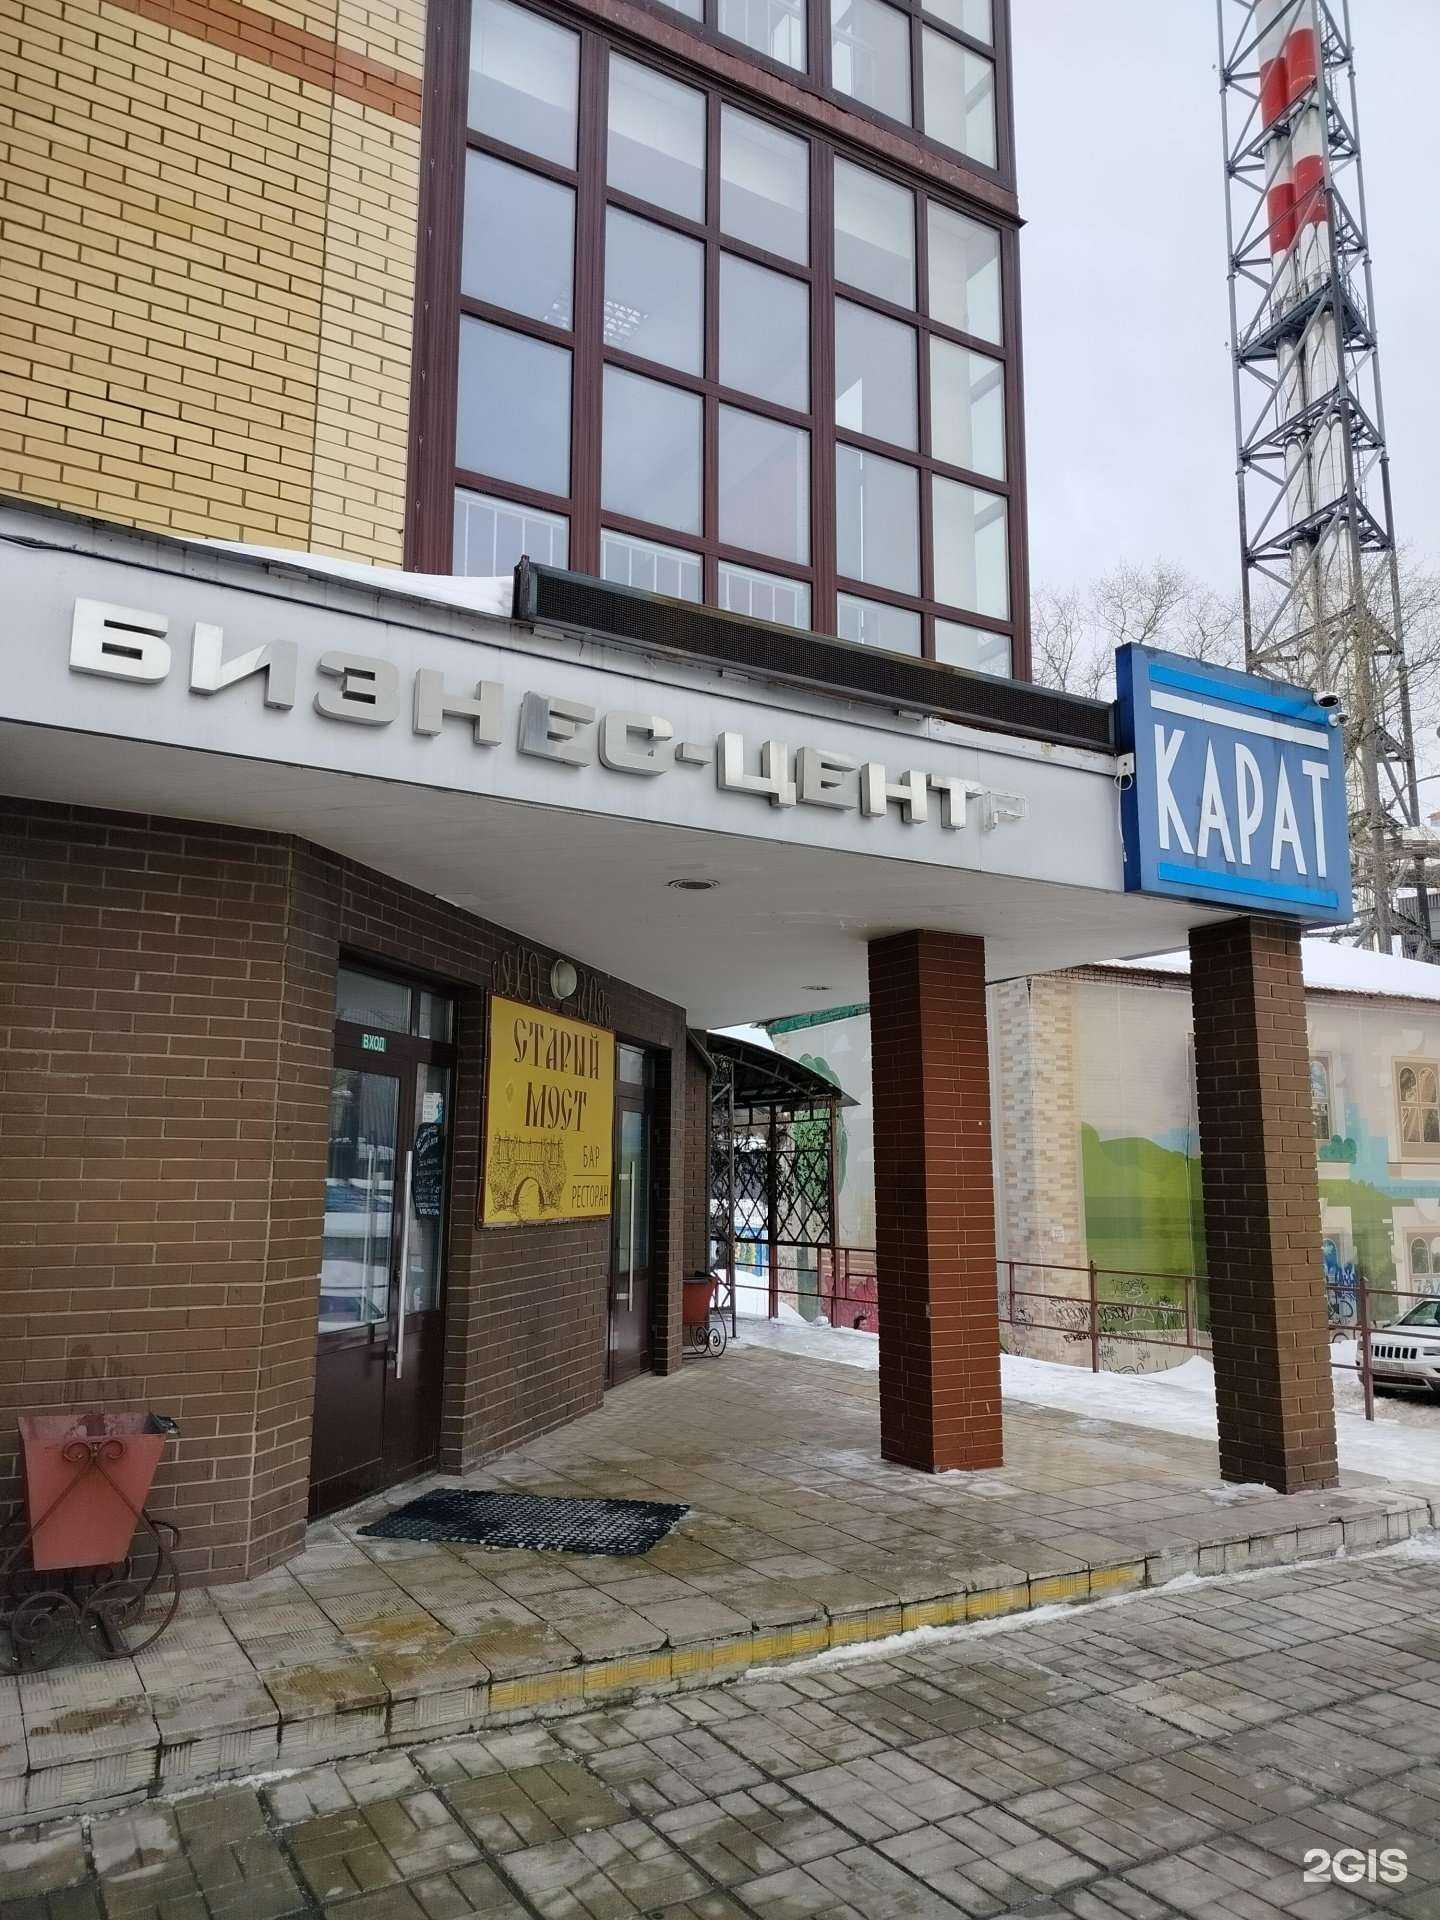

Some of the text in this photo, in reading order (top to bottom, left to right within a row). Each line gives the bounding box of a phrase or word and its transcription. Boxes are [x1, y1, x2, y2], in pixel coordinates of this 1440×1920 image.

[68, 597, 1027, 833] БИЗНЕС-ЦЕНТР
[1154, 723, 1329, 878] КАРАТ
[362, 1033, 385, 1053] ВХОД
[513, 1017, 601, 1080] СТАРЫЙ
[523, 1081, 588, 1132] МОСТ
[583, 1144, 600, 1169] БАР
[571, 1184, 609, 1209] РЕСТОРАН
